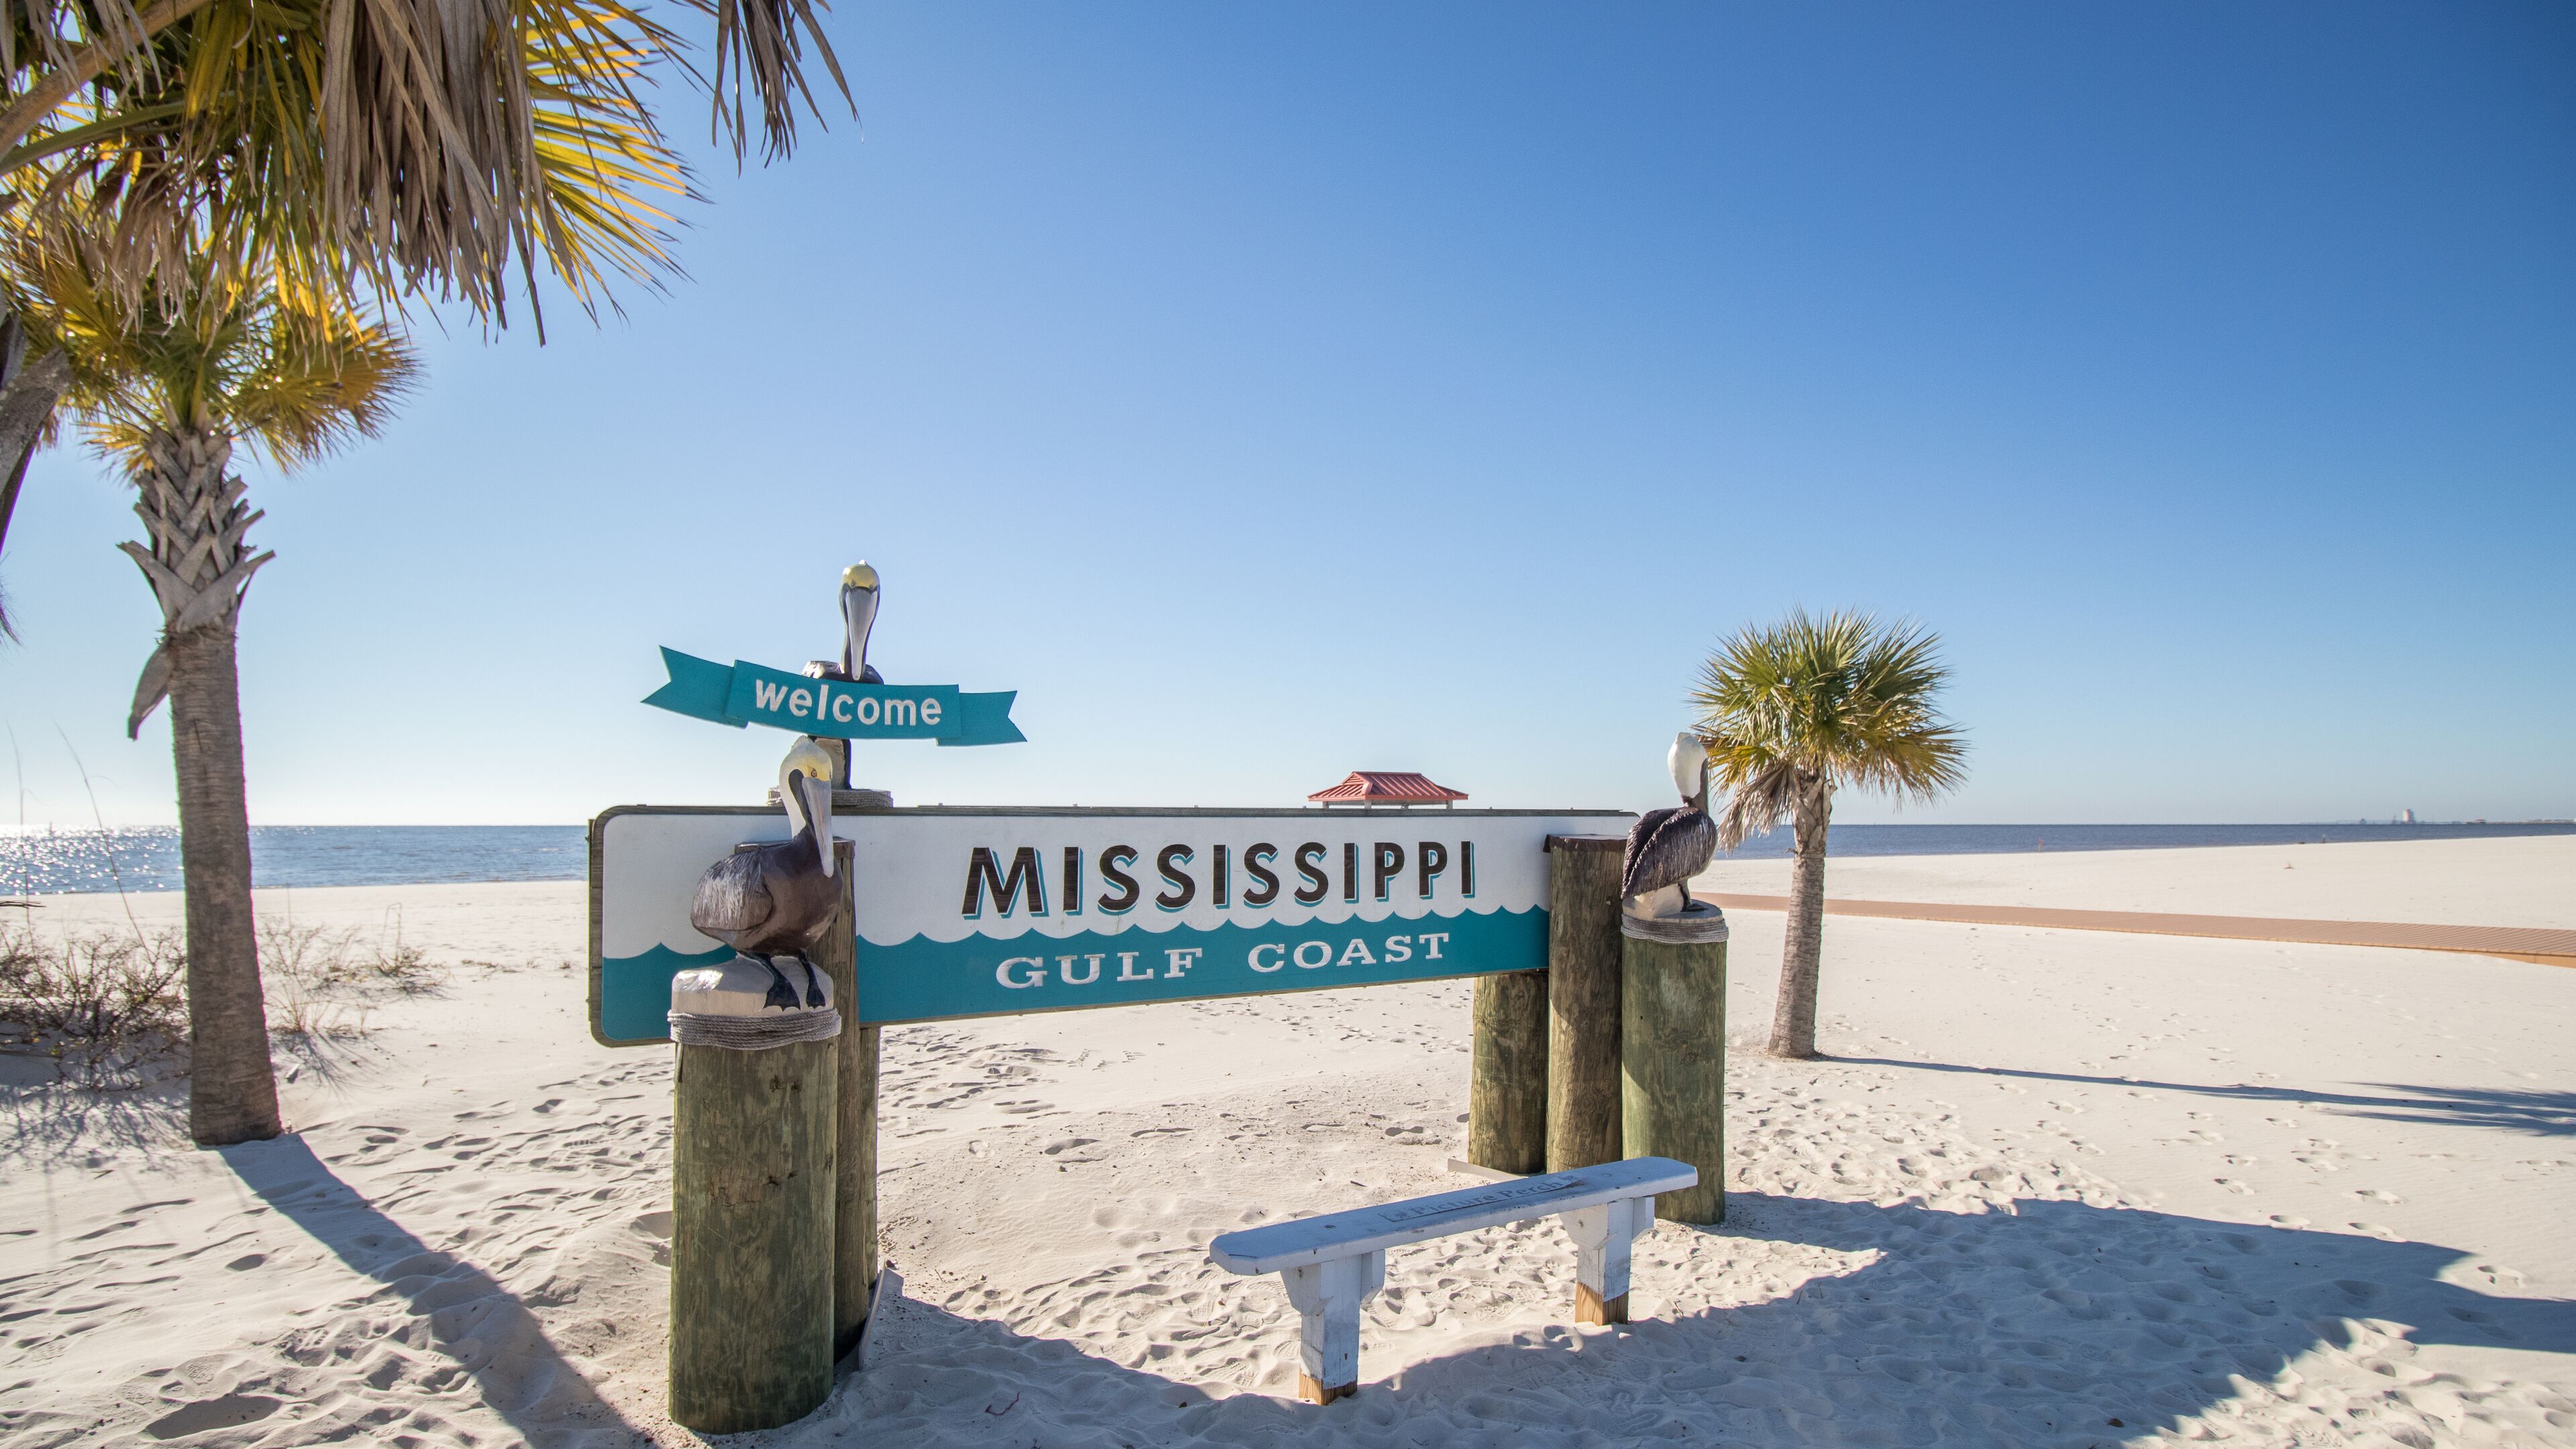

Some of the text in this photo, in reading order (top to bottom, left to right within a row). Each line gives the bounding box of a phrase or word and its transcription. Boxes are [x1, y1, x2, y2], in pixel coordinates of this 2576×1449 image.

[755, 679, 942, 726] welcome
[961, 841, 1476, 920] MISSISSIPPI
[996, 932, 1450, 989] GULF COAST
[1412, 1181, 1562, 1215] Picture Perch
